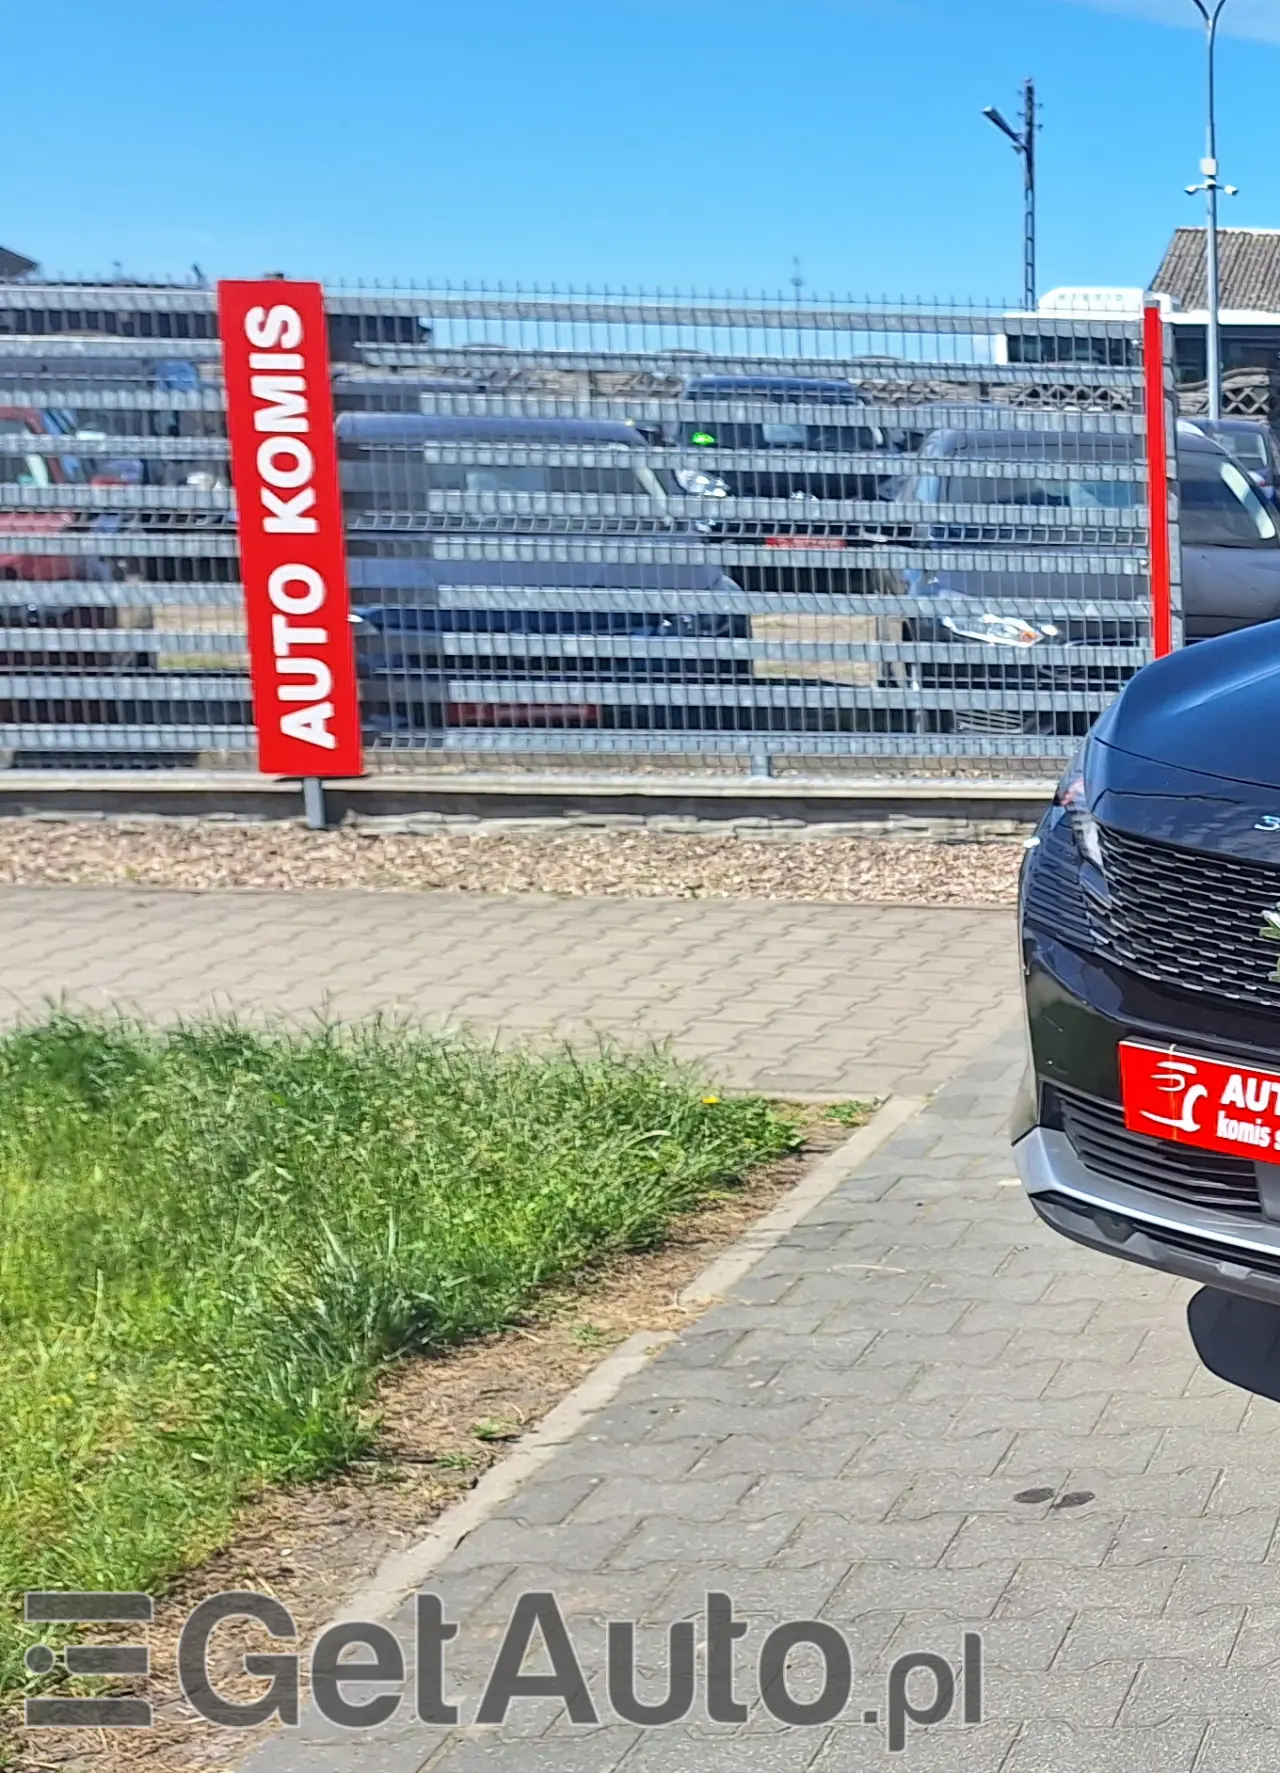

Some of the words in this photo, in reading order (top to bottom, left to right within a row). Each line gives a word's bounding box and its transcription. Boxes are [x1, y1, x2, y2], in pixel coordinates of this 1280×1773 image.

[245, 304, 317, 534] KOMIS
[268, 562, 336, 749] AUTO
[1216, 1110, 1271, 1147] komis
